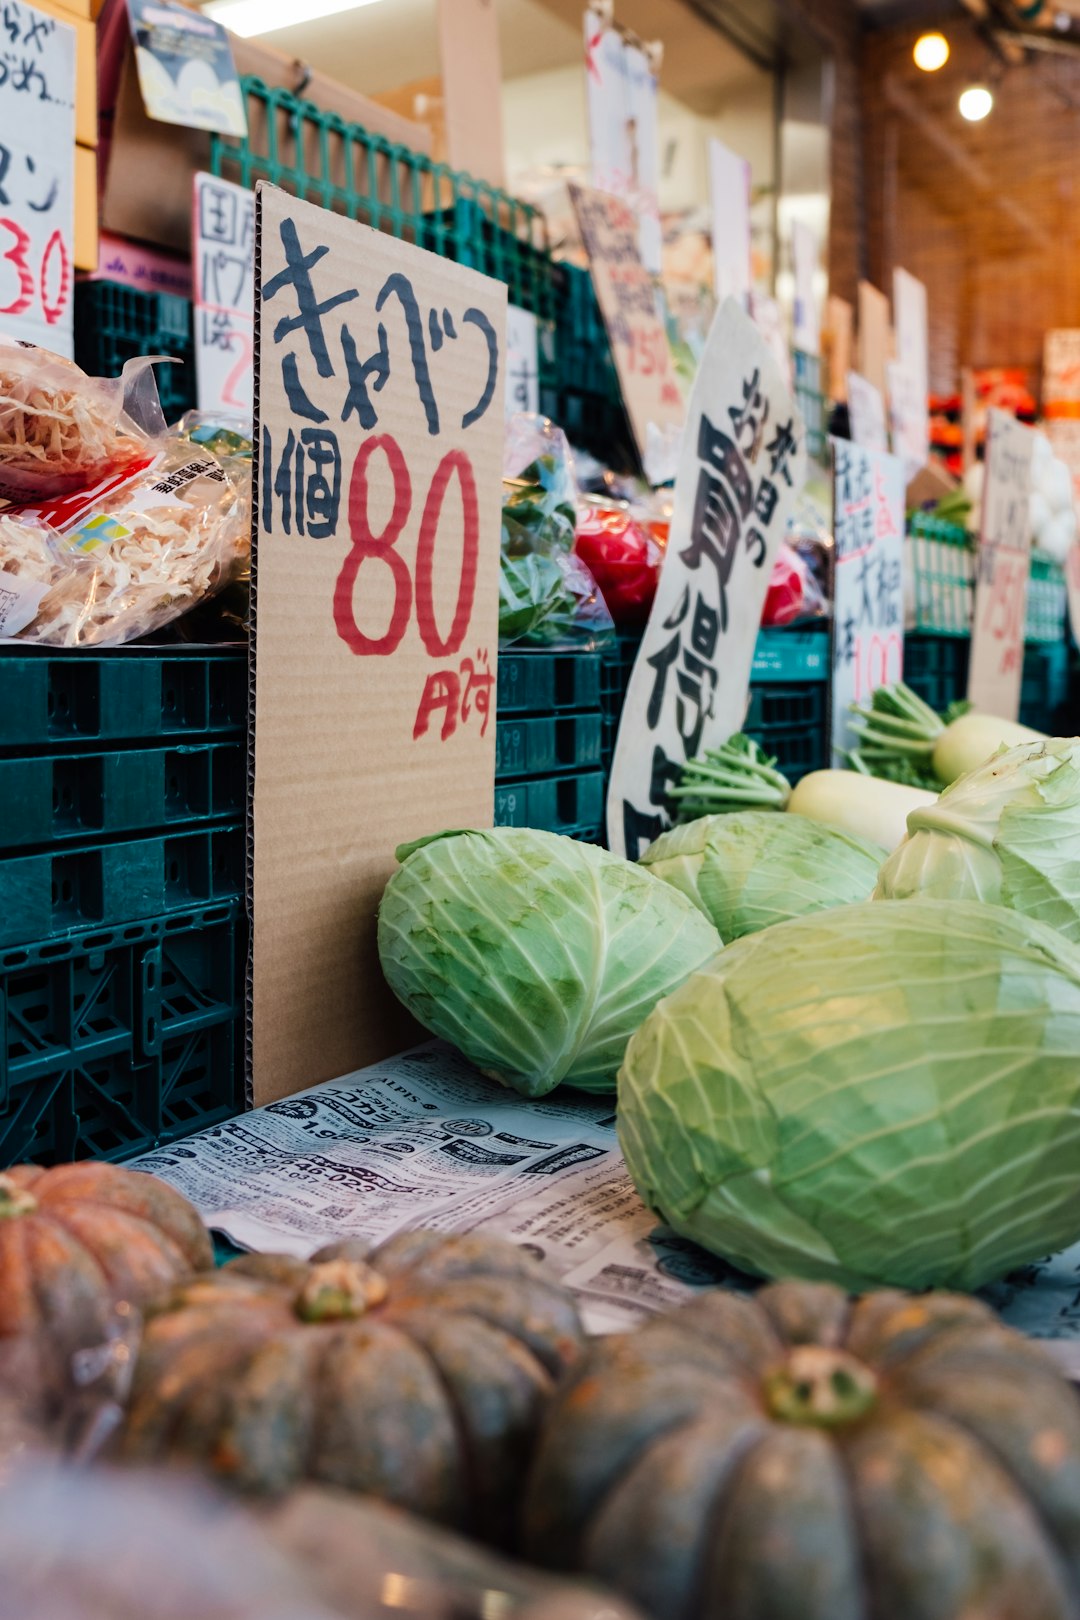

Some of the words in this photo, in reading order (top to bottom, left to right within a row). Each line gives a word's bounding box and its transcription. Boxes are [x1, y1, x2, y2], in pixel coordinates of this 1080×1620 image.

[262, 216, 498, 436] きゃべつ
[333, 433, 480, 658] 80
